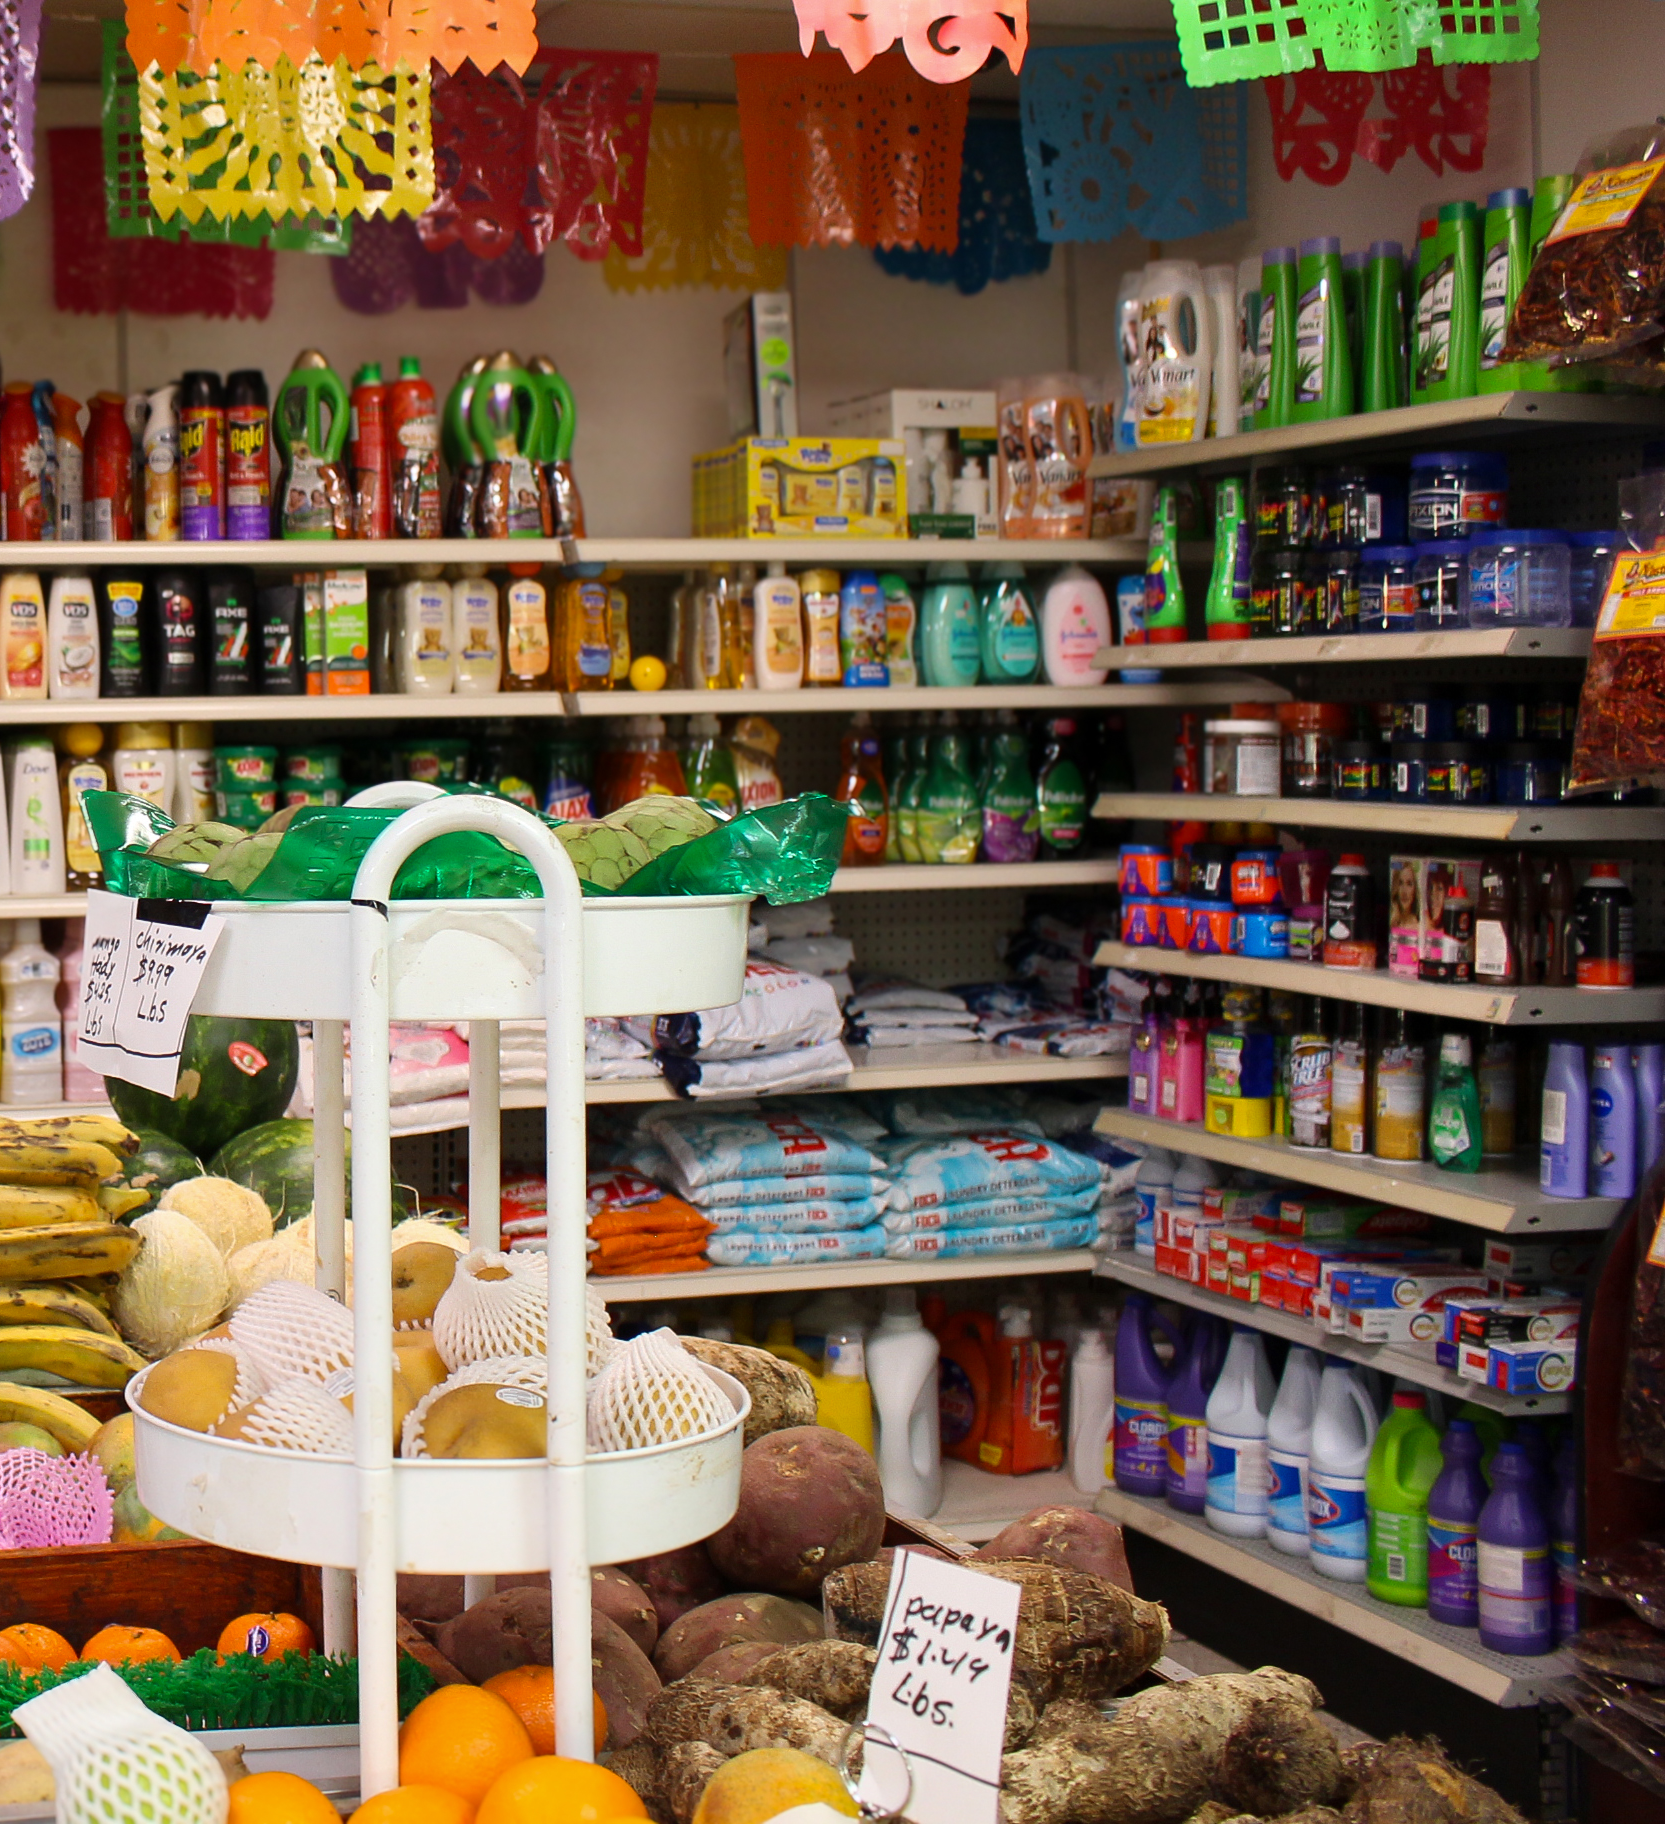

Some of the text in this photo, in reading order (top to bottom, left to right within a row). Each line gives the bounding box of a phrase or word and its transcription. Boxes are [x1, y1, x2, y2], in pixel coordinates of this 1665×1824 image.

[230, 422, 265, 457] Raid
[215, 607, 247, 619] AXE
[163, 624, 196, 638] TAG
[263, 624, 290, 634] AXE
[23, 762, 50, 776] Dove
[133, 953, 175, 989] $9.99
[903, 1595, 1014, 1654] papaya
